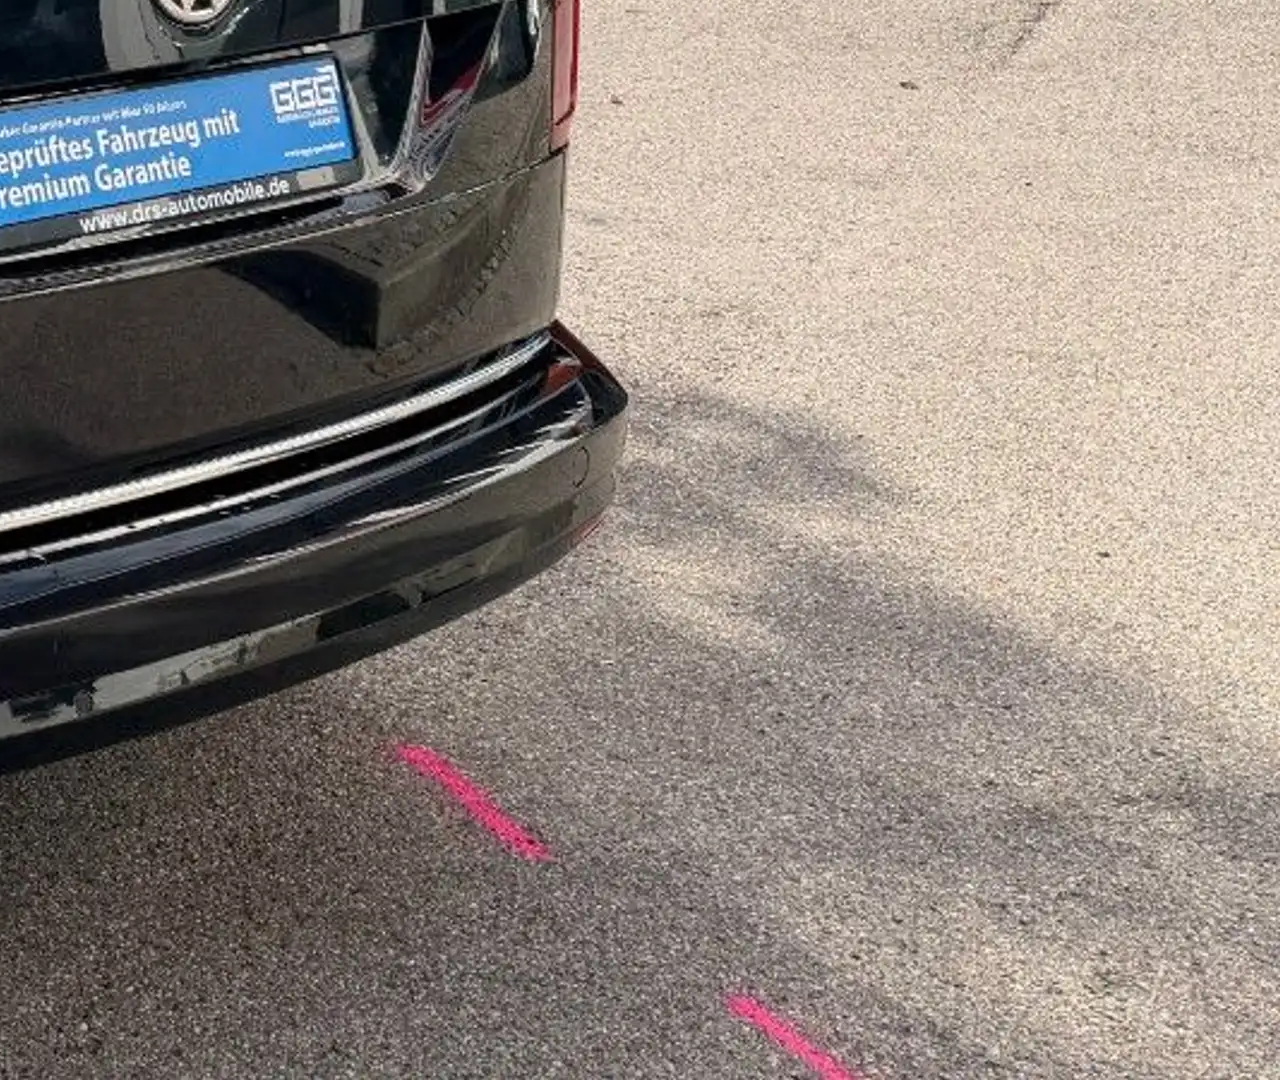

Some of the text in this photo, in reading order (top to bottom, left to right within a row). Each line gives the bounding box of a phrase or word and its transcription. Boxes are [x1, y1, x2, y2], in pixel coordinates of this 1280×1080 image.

[97, 118, 200, 158] Fahrzeug
[204, 110, 241, 136] mit
[94, 153, 191, 194] Garantie
[79, 178, 291, 235] www.drs-automobile.de
